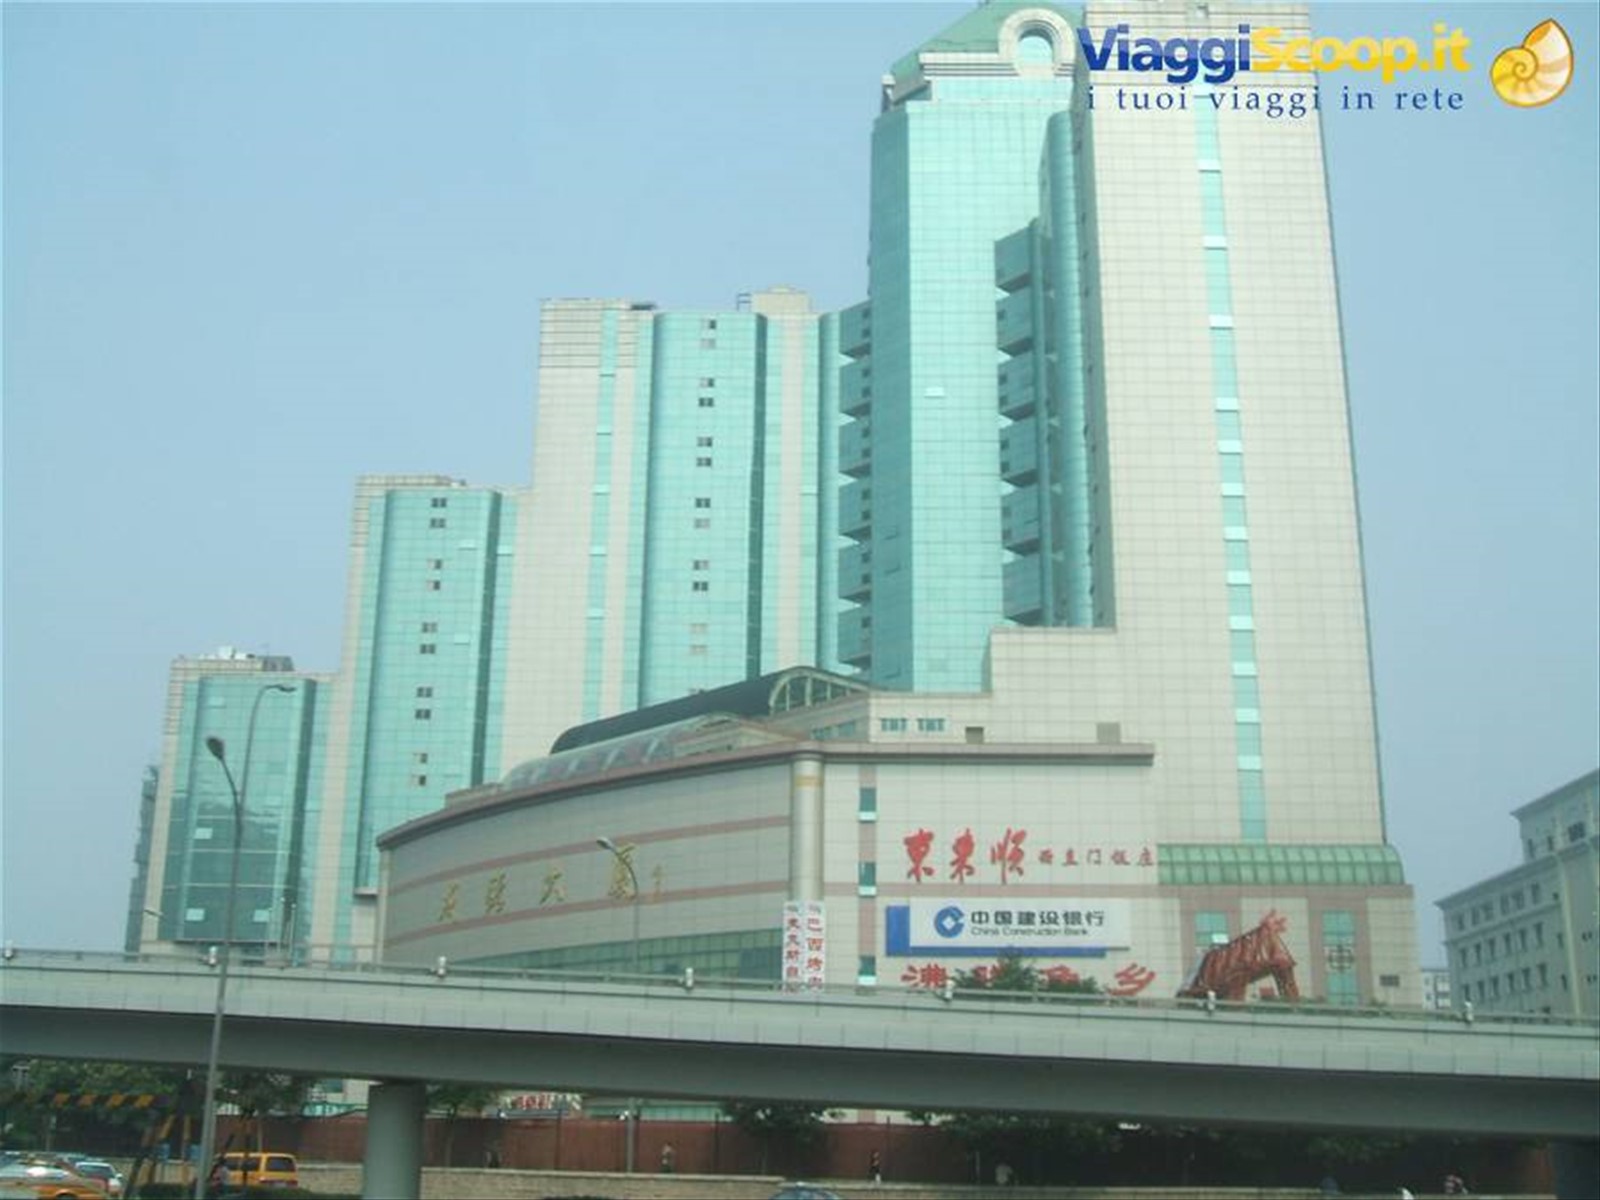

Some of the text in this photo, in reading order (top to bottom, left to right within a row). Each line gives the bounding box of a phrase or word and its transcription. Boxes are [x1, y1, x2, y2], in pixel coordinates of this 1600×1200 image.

[970, 909, 1105, 927] 中国建设银行
[970, 927, 1089, 937] China Construction Bank
